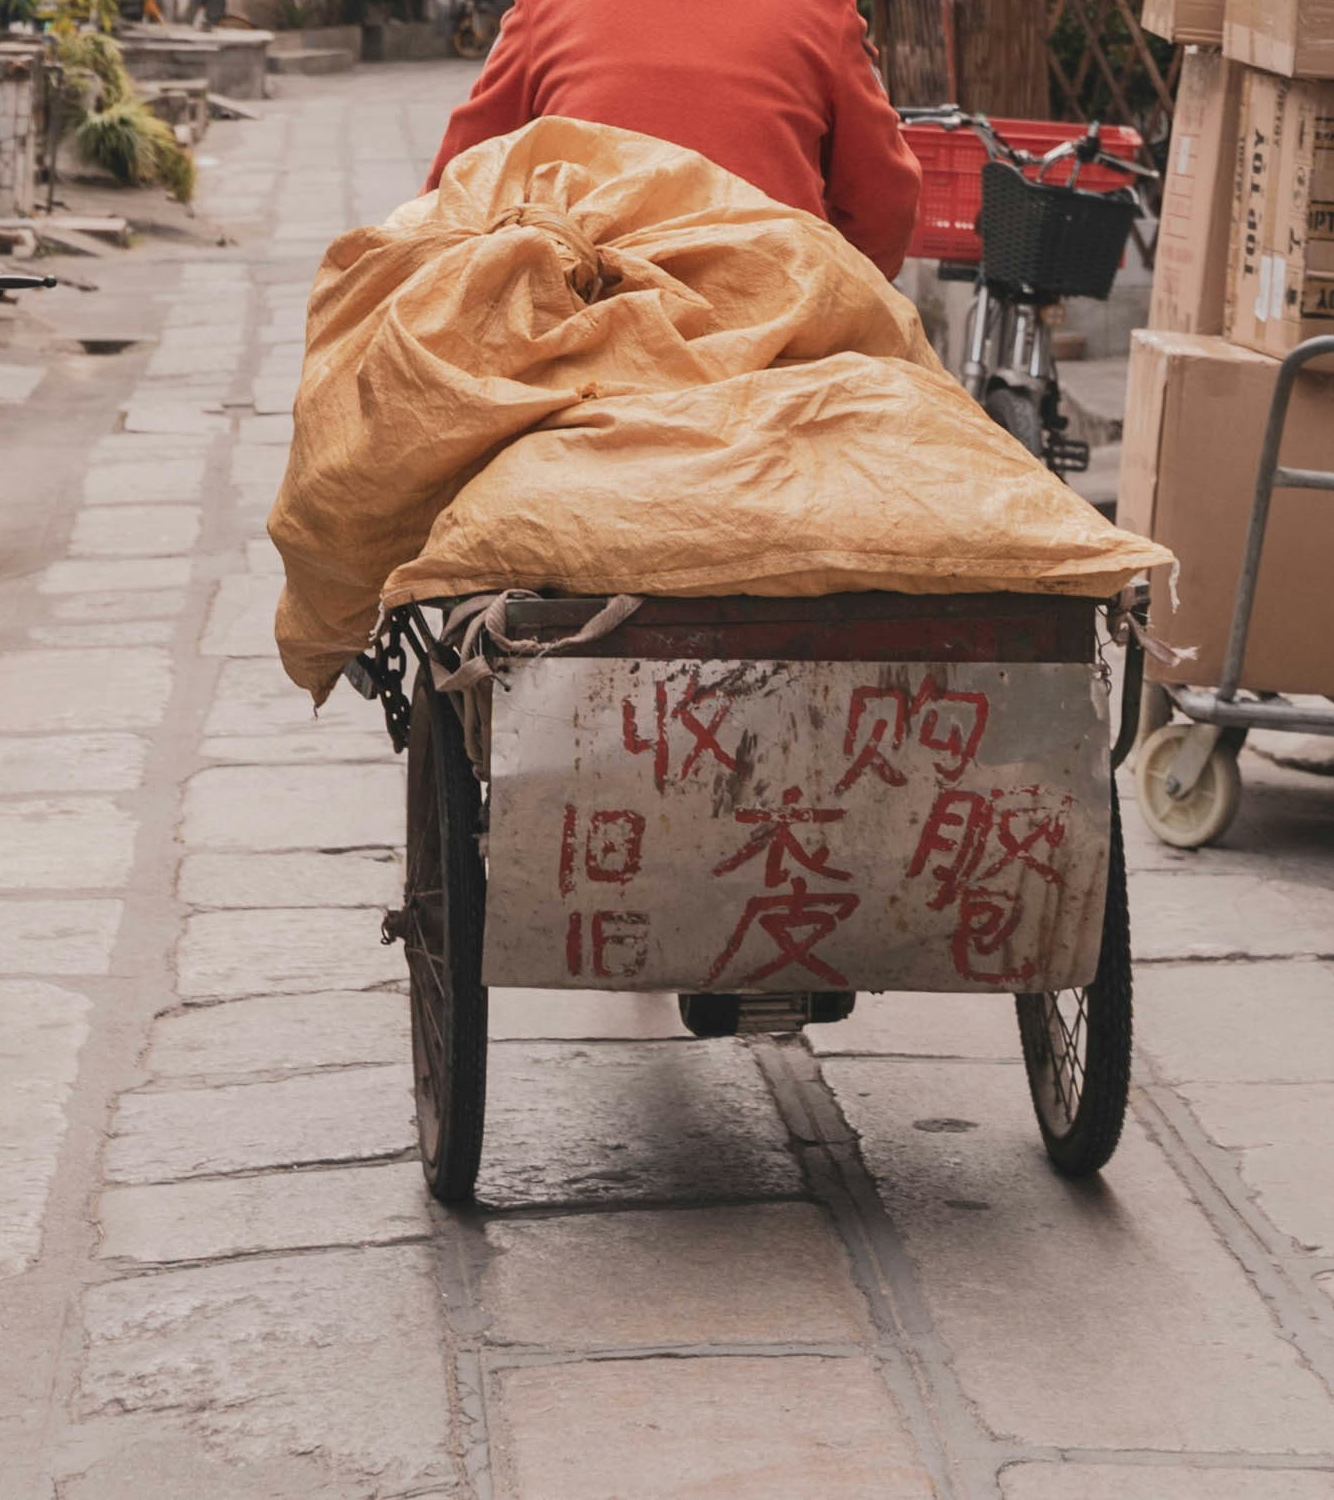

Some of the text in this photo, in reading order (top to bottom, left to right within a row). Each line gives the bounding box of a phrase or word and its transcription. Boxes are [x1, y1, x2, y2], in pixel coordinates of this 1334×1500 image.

[622, 678, 988, 794] 收购
[555, 783, 1077, 912] 旧衣服
